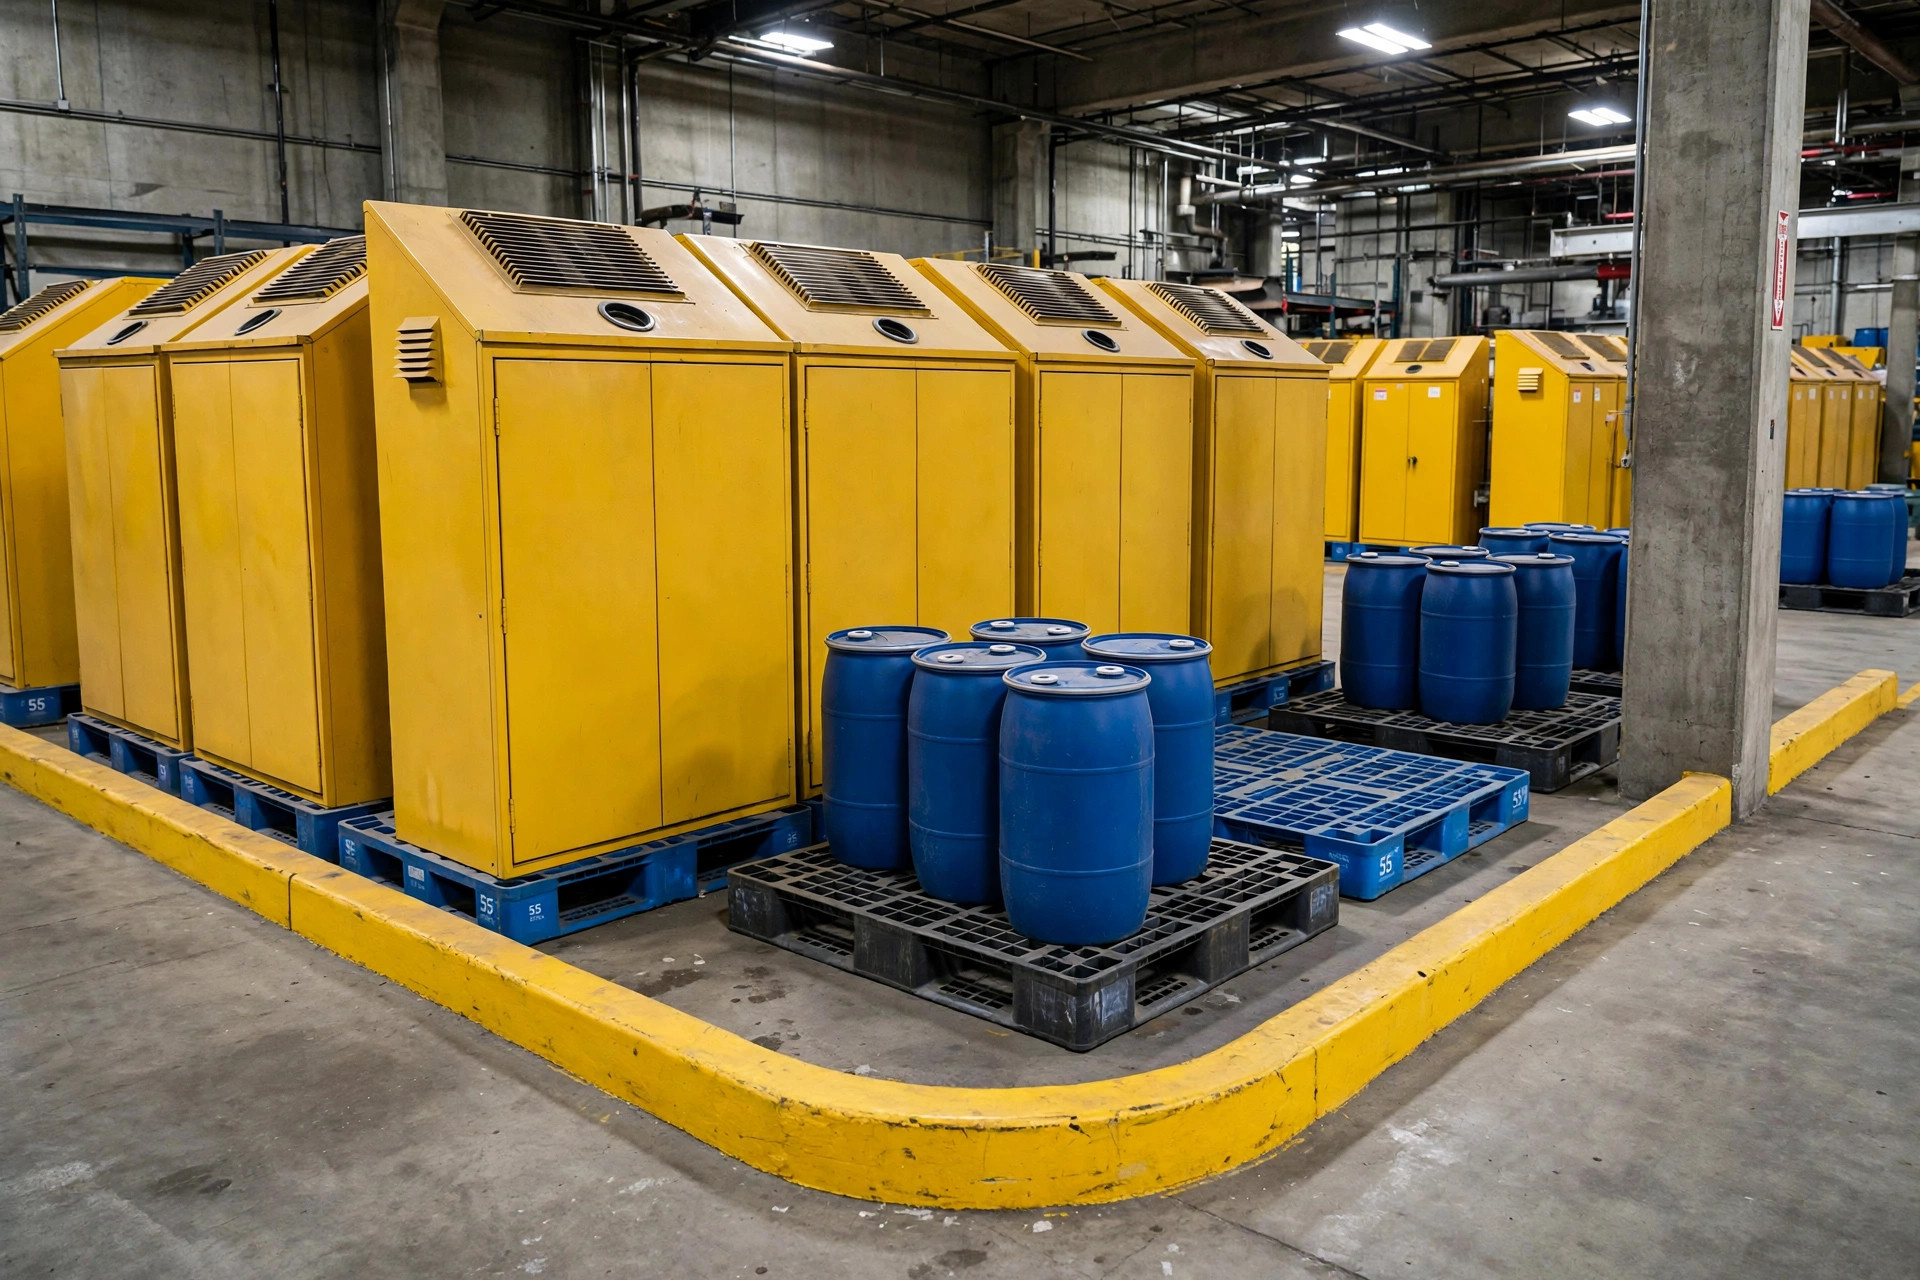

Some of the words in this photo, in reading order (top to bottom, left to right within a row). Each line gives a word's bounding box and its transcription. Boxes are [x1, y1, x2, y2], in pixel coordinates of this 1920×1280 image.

[28, 697, 45, 711] 55
[479, 894, 493, 915] 55
[529, 903, 541, 916] 55
